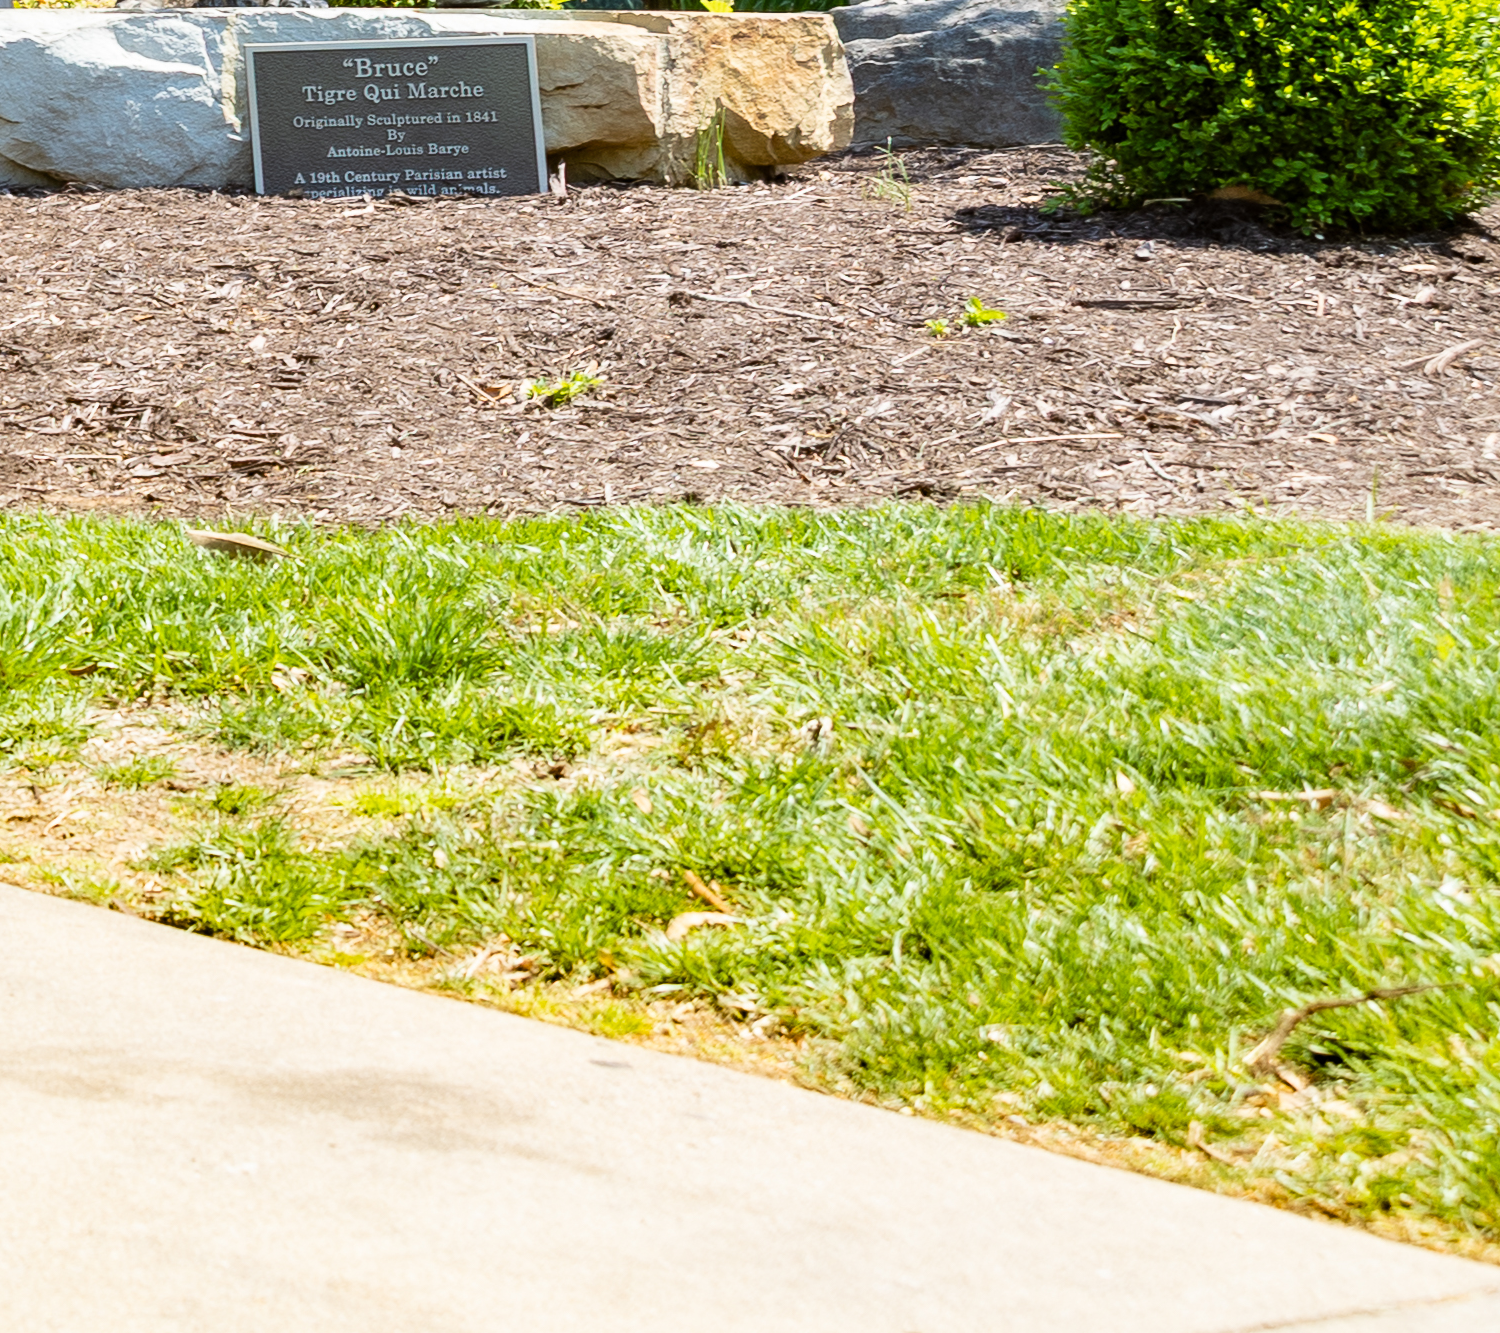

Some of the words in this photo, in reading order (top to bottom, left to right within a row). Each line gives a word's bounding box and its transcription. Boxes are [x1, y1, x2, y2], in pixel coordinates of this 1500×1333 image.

[342, 55, 439, 78] "Bruce"
[302, 85, 358, 105] Tigre
[363, 83, 401, 104] Qui
[407, 81, 485, 99] Marche
[293, 113, 363, 130] Originally
[367, 112, 442, 129] Sculptured
[446, 112, 462, 124] in
[465, 110, 499, 123] 1841
[387, 129, 406, 142] By
[326, 143, 424, 158] Antoine-Louis
[428, 143, 470, 157] Barye
[294, 173, 306, 184] A
[310, 171, 341, 184] 19th
[344, 170, 401, 184] Century
[404, 169, 464, 181] Parisian
[466, 168, 508, 180] artist
[408, 183, 437, 195] wild
